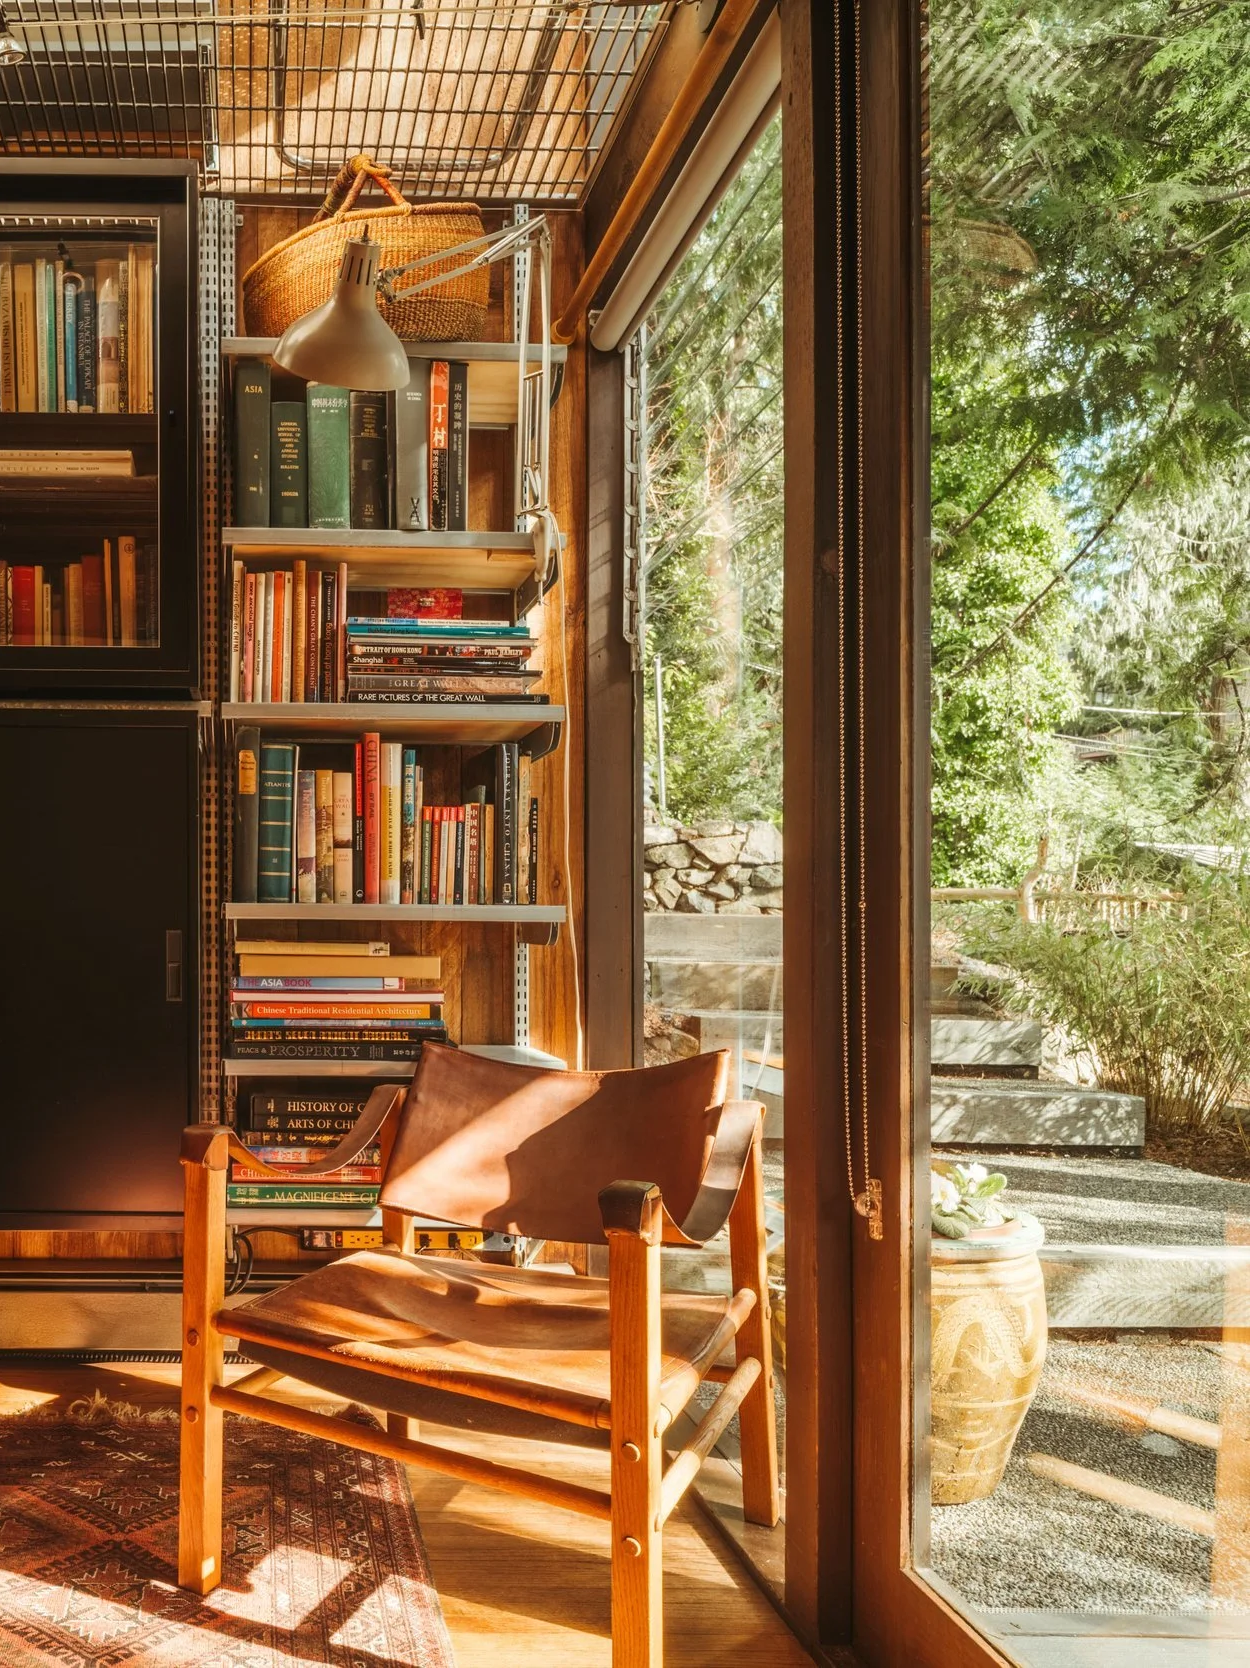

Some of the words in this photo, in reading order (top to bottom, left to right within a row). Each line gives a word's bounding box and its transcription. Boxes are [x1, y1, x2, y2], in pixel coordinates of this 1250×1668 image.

[66, 291, 74, 323] TURKEY
[0, 296, 10, 337] BAZAARS
[78, 321, 84, 329] IN
[2, 338, 10, 351] OF
[84, 346, 91, 357] OF
[3, 352, 11, 396] ISTANBUL
[244, 385, 263, 394] ASIA
[432, 402, 447, 448] 丁村
[326, 622, 334, 641] kong
[353, 656, 384, 664] Shanghai
[394, 679, 431, 687] GREAT
[432, 680, 459, 688] WALL
[358, 693, 376, 702] RARE
[378, 693, 410, 702] PICTURES
[412, 693, 424, 702] OF
[424, 694, 438, 702] THE
[439, 694, 463, 702] GREAT
[465, 694, 485, 702] WALL
[366, 739, 377, 784] CHINA
[405, 764, 414, 777] THE
[405, 777, 414, 805] CHINESE
[369, 792, 375, 802] BY
[242, 979, 260, 987] THE
[260, 979, 283, 987] ASIA
[283, 979, 312, 987] BOOK
[256, 1006, 286, 1014] Chinese
[288, 1006, 330, 1014] Traditional
[332, 1006, 374, 1015] Residential
[375, 1007, 422, 1015] Architecture
[244, 1030, 282, 1039] CHINA'S
[285, 1031, 316, 1040] SEVEN
[318, 1031, 359, 1040] ANCIENT
[362, 1031, 409, 1041] CAPITALS
[269, 1045, 360, 1057] PROSPERITY
[287, 1101, 337, 1113] HISTORY
[338, 1101, 354, 1113] OF
[287, 1119, 314, 1129] ARTS
[316, 1119, 332, 1129] OF
[334, 1119, 355, 1130] CHI
[274, 1191, 359, 1202] MAGNIFICENT
